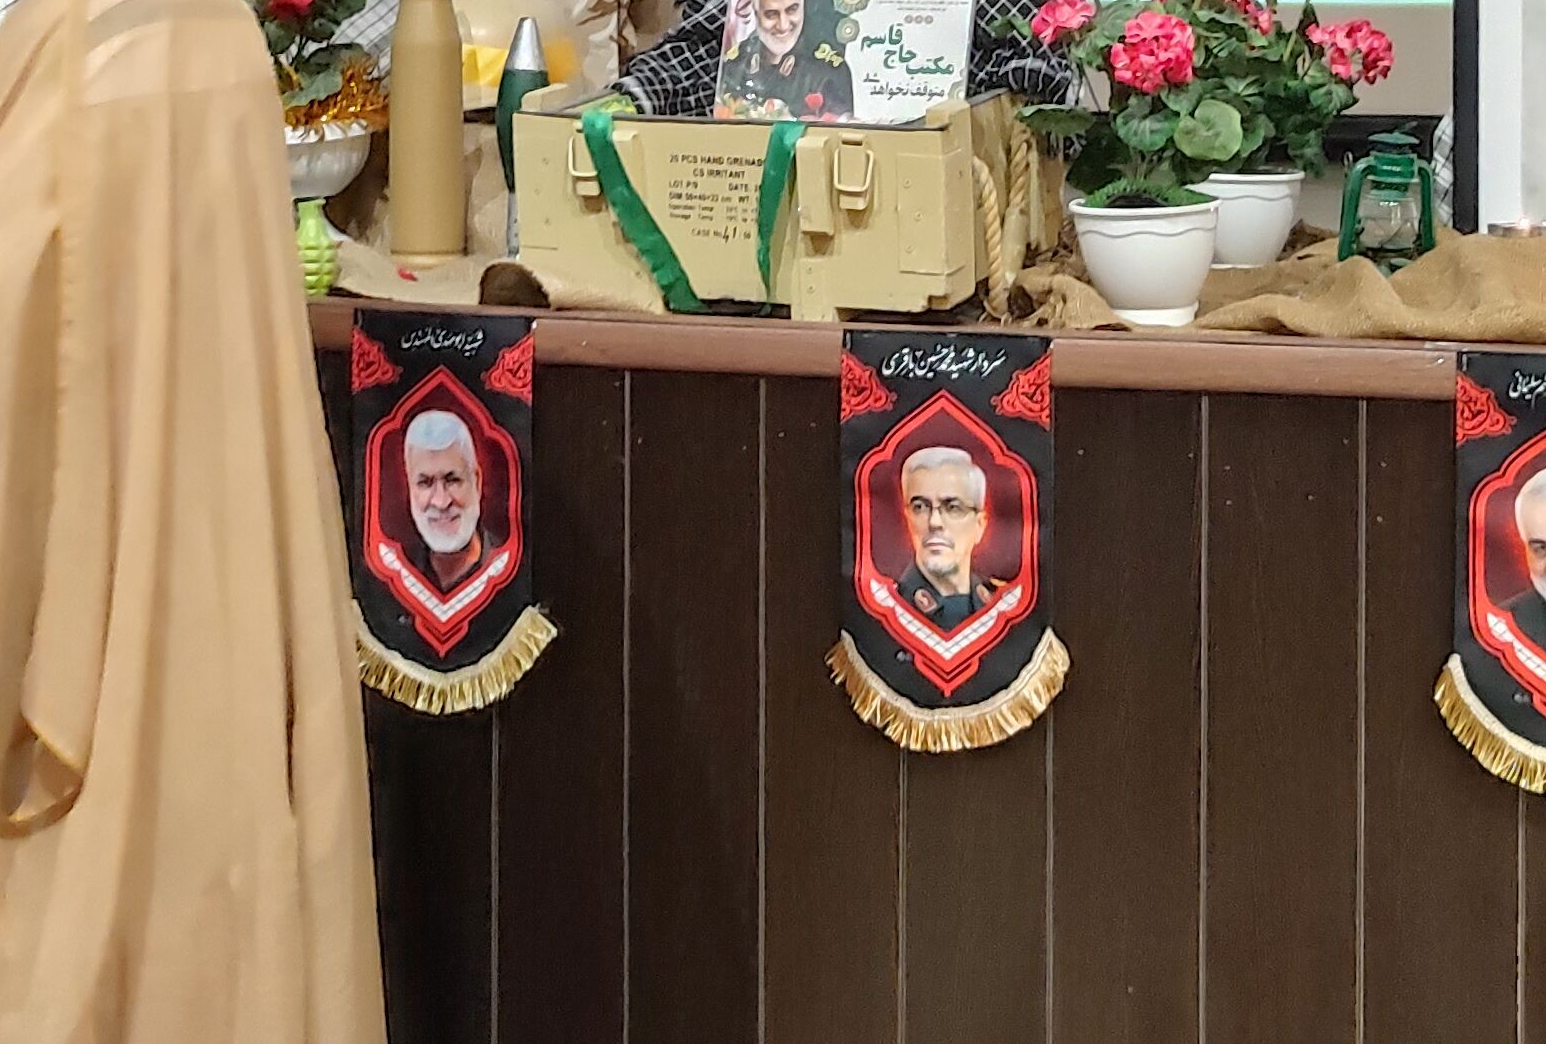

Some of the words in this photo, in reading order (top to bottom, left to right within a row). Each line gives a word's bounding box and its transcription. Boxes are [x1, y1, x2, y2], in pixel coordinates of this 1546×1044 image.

[861, 23, 903, 51] قاسم
[883, 44, 917, 69] حاج
[906, 56, 954, 80] مکتب
[863, 72, 880, 83] شد
[870, 82, 910, 101] نخواهد
[911, 80, 945, 102] متوقف
[701, 156, 724, 165] HAND
[726, 157, 764, 167] GRENAD
[882, 347, 914, 378] باقری
[969, 349, 1006, 378] سردار
